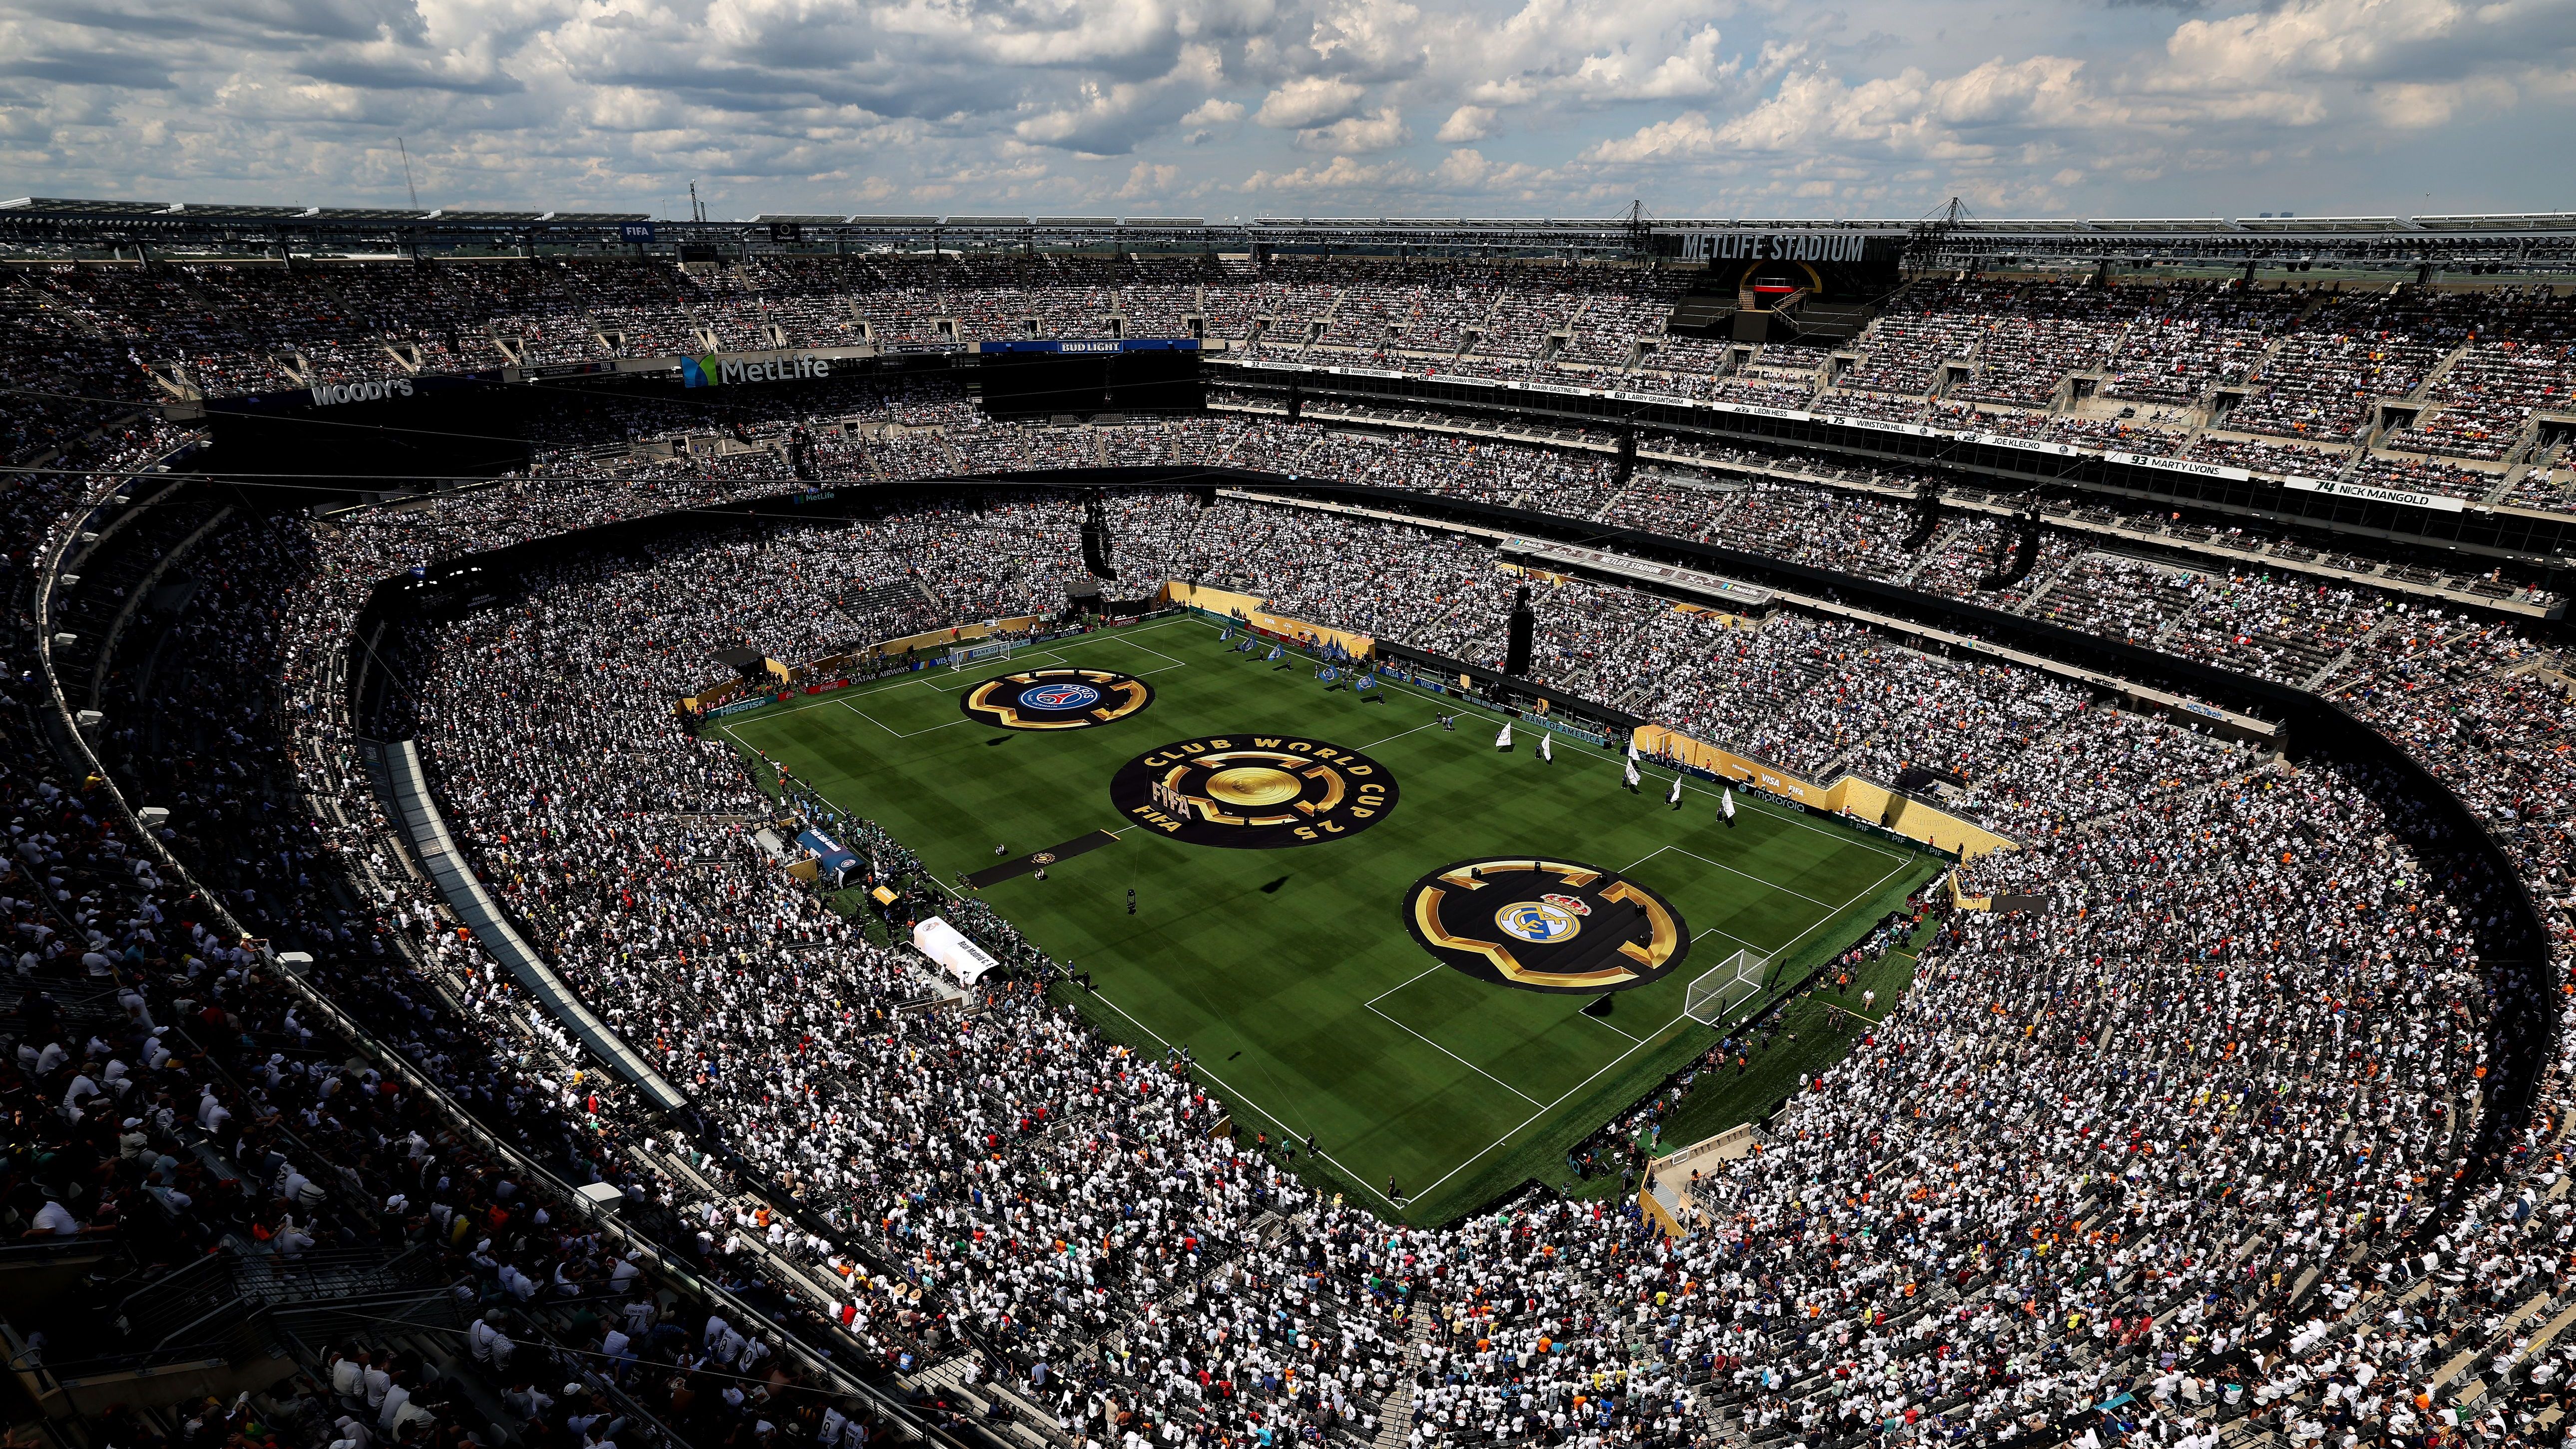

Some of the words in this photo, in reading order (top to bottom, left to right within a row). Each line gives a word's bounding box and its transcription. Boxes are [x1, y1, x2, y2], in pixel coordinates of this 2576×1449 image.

[626, 227, 649, 236] FIFA
[1682, 234, 1765, 260] METLIFE
[1770, 235, 1866, 262] STADIUM
[1061, 342, 1086, 351] BUD
[721, 354, 829, 383] MetLife
[312, 379, 414, 406] MOODY'S
[1549, 386, 1580, 395] GASTINEAU
[1649, 396, 1684, 405] GRANTHAM
[1857, 421, 1890, 430] WINSTON
[2008, 439, 2041, 450] KLECKO
[2130, 455, 2148, 466] 93
[2151, 460, 2188, 471] MARTY
[2188, 464, 2221, 475] LYONS
[807, 491, 834, 500] MetLife
[2314, 481, 2336, 492] 74
[2339, 484, 2366, 496] NICK
[2366, 489, 2430, 506] MANGOLD
[1523, 541, 1545, 549] MetLife
[1600, 556, 1631, 568] METLIFE
[1629, 561, 1663, 574] STADIUM
[1731, 585, 1758, 596] MetLife
[1204, 610, 1230, 624] Hisense
[820, 682, 839, 692] Coca-Cola
[851, 673, 876, 685] QATAR
[878, 665, 910, 679] AIRWAYS
[974, 647, 990, 656] BANK
[1384, 667, 1399, 679] VISA
[1420, 679, 1435, 690] VISA
[2091, 676, 2117, 689] verizon
[1062, 685, 1094, 699] PARIS
[720, 699, 765, 716] Hisense
[1472, 696, 1481, 705] YORK
[1491, 703, 1505, 713] JERSEY
[2186, 702, 2222, 720] HCLTech
[1525, 714, 1547, 727] BANK
[1549, 722, 1560, 731] OF
[1561, 727, 1601, 744] AMERICA
[1144, 739, 1232, 767] CLUB
[1254, 738, 1373, 776] WORLD
[1732, 763, 1752, 775] Hisense
[1761, 772, 1780, 788] VISA
[1788, 785, 1804, 797] FIFA
[1152, 781, 1191, 820] FIFA
[1349, 784, 1385, 818] CUP
[1754, 790, 1805, 813] motorola
[1132, 805, 1183, 833] FIFA
[809, 828, 822, 837] Paris
[1293, 819, 1345, 840] 25
[1856, 823, 1869, 832] PIF
[1892, 835, 1906, 844] PIF
[1929, 847, 1943, 857] PIF
[957, 941, 970, 952] Real
[967, 948, 986, 962] Madrid
[630, 1314, 641, 1330] 7
